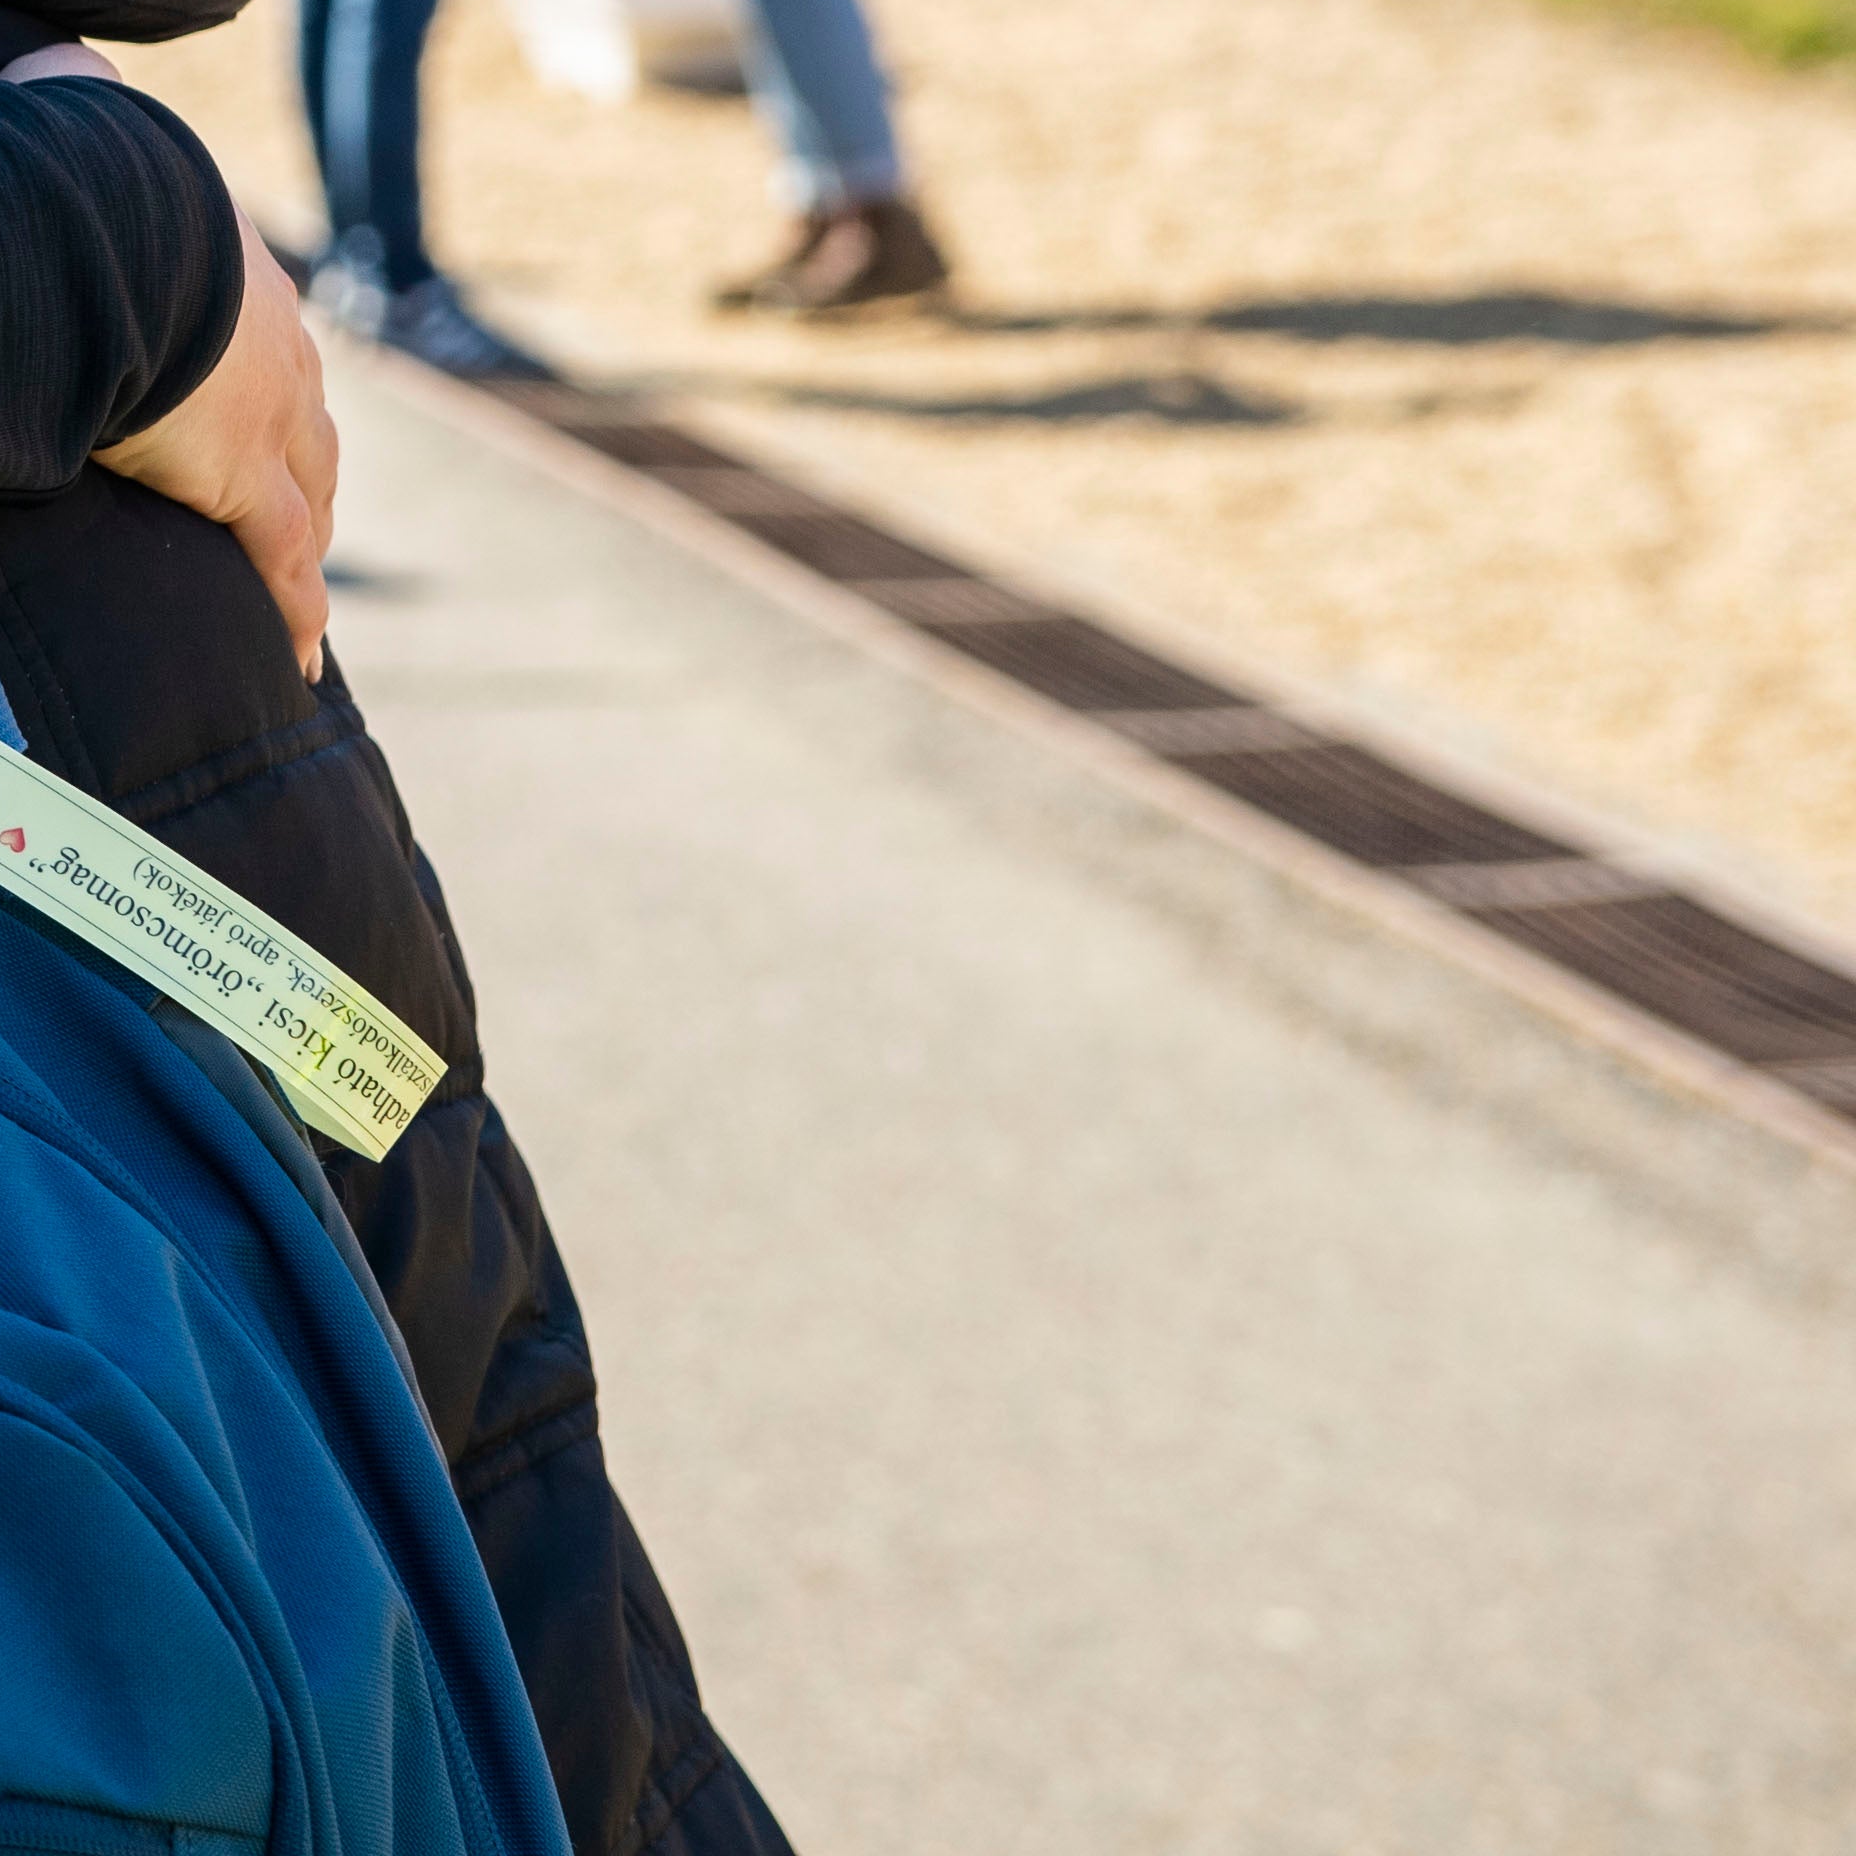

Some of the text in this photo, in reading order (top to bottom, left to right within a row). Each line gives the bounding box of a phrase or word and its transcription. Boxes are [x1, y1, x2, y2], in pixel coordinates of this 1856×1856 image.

[133, 857, 233, 933] játékok)
[226, 925, 279, 965] apró
[258, 998, 337, 1071] kicsi
[333, 1058, 410, 1129] adható
